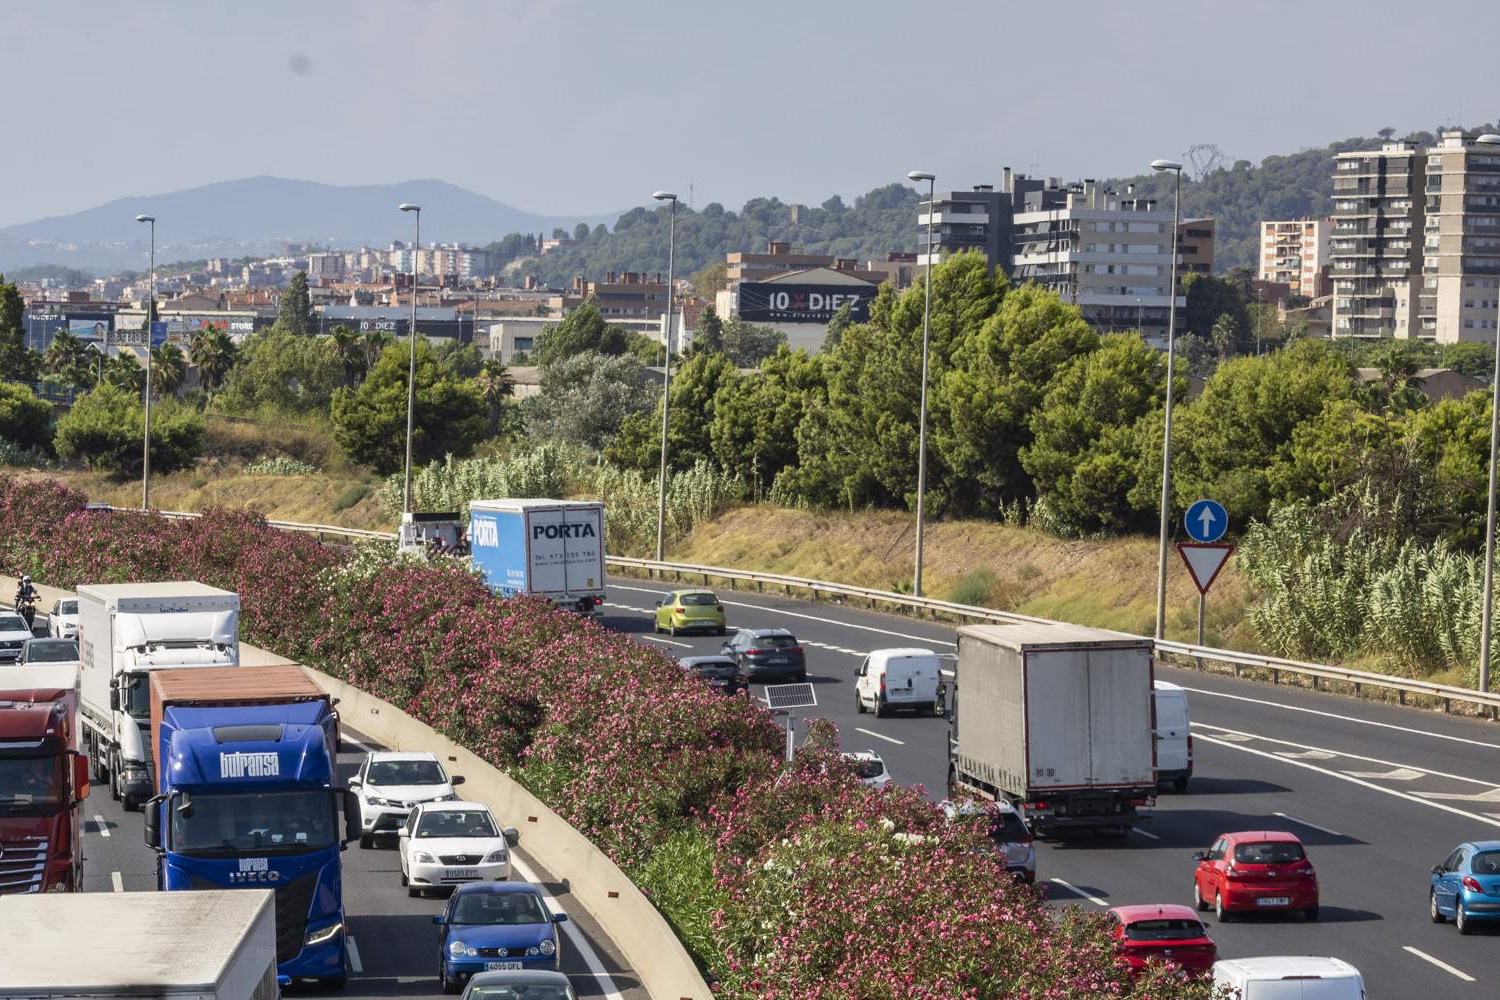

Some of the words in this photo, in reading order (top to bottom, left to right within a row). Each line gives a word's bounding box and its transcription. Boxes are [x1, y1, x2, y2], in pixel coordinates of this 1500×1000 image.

[769, 292, 789, 310] 10
[809, 293, 860, 312] DIEZ
[473, 518, 499, 548] PORTA
[533, 523, 596, 540] PORTA
[219, 751, 280, 778] butransa
[229, 871, 280, 883] IVECO
